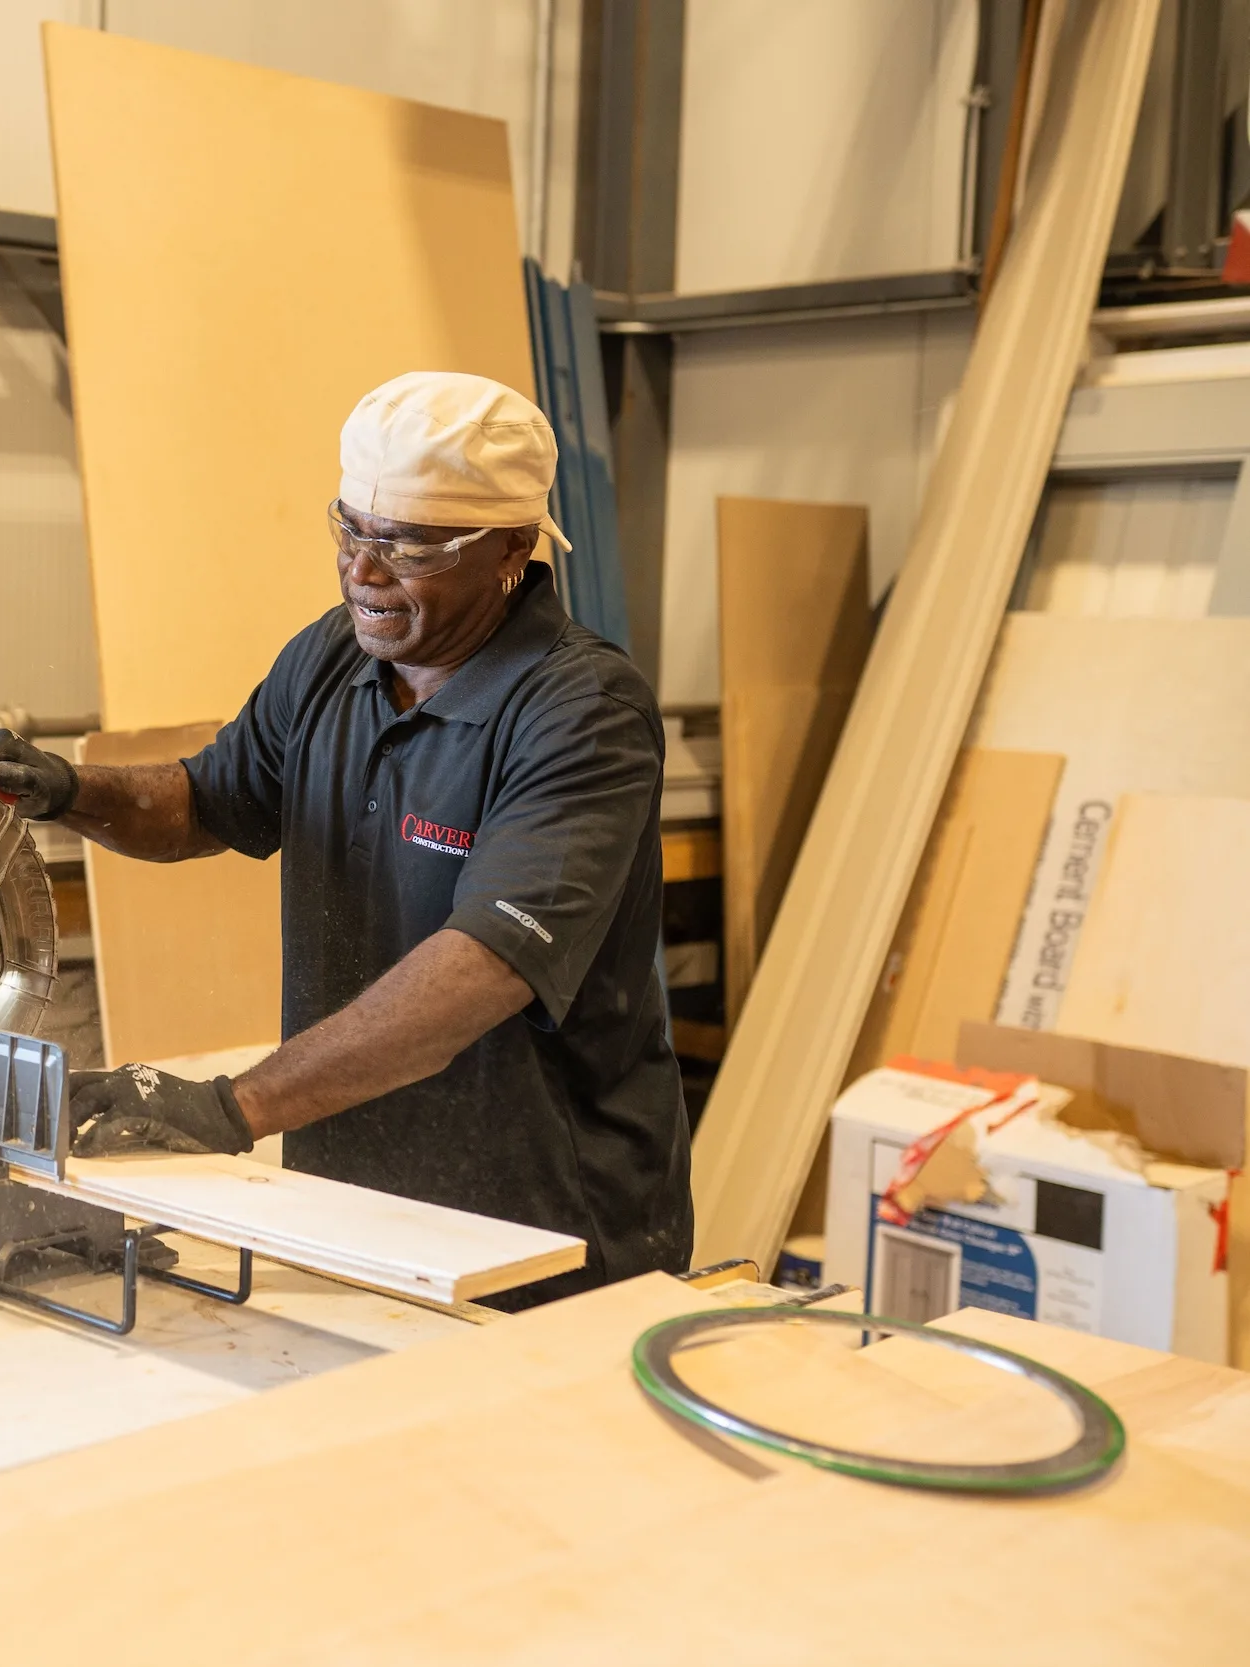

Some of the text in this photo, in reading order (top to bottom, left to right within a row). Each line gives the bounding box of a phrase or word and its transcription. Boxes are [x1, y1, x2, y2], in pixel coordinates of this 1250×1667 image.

[401, 813, 478, 848] CARVER
[412, 835, 465, 857] CONSTRUCTION
[1055, 800, 1113, 902] Cement
[1030, 909, 1085, 992] Board
